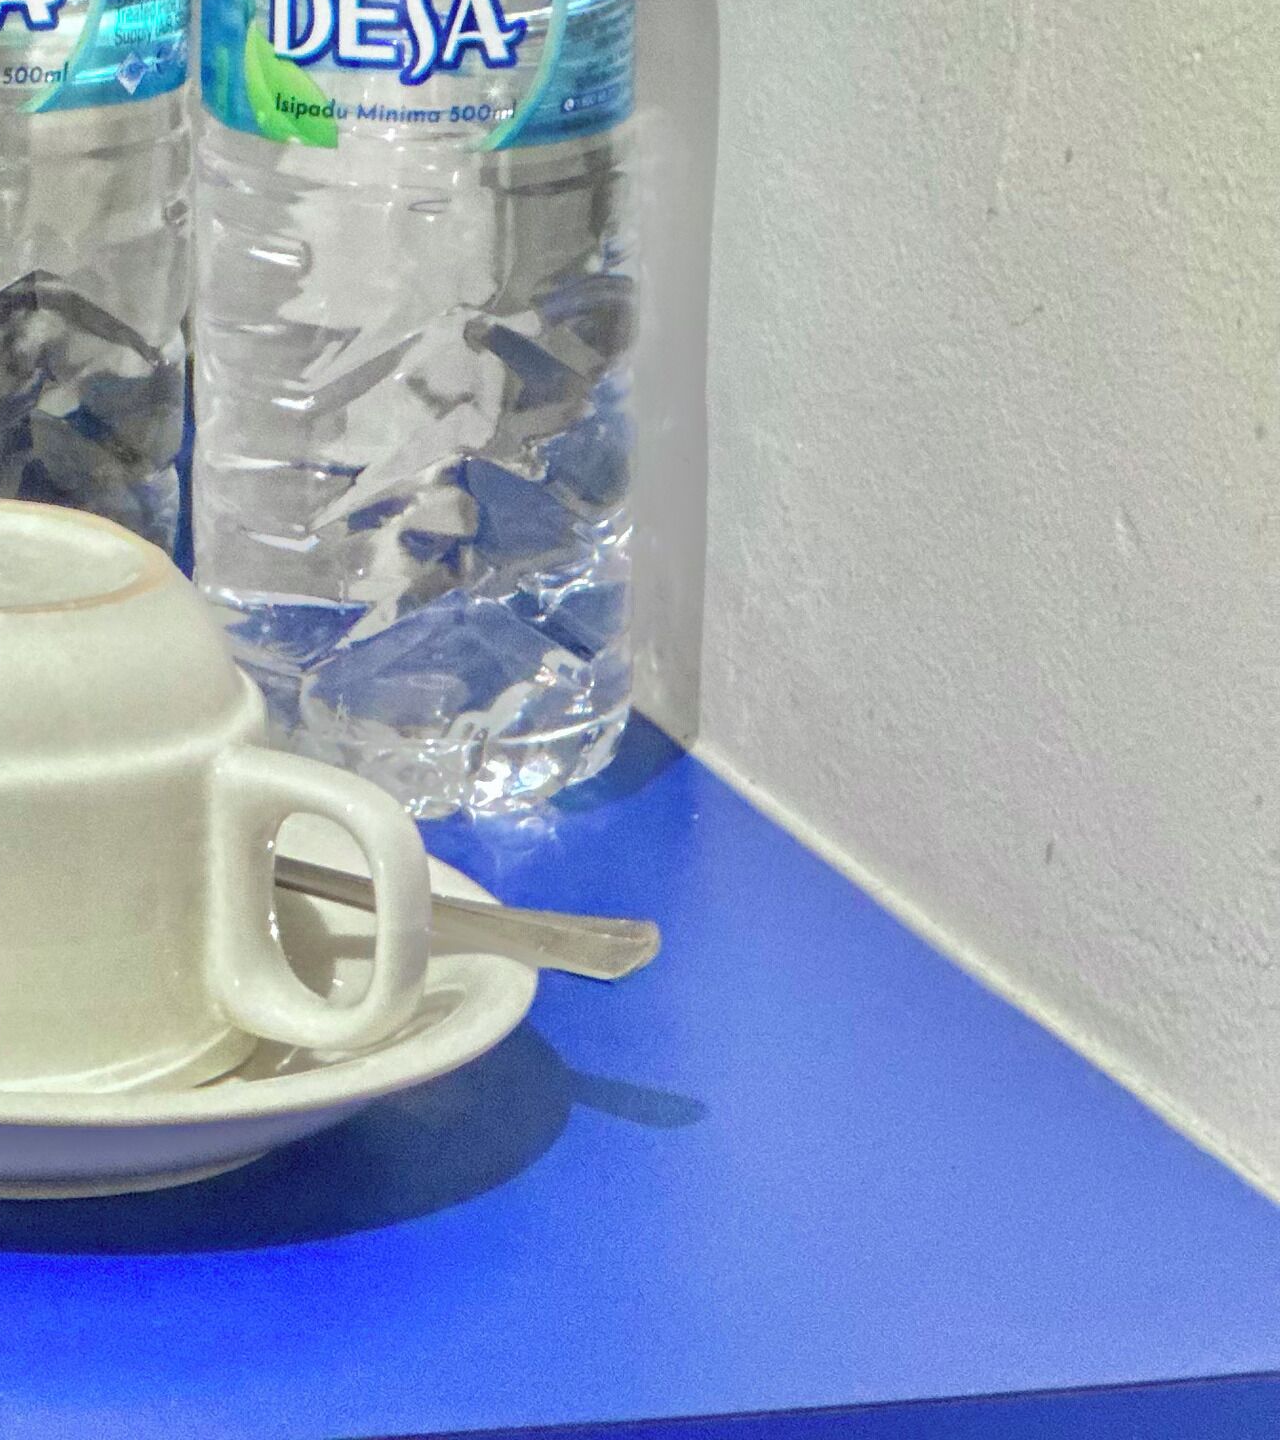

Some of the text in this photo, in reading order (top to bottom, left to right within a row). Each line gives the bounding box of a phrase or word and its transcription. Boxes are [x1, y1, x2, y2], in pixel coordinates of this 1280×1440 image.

[2, 62, 69, 85] 500ml
[275, 93, 349, 121] Isipadu
[356, 103, 442, 123] Minima
